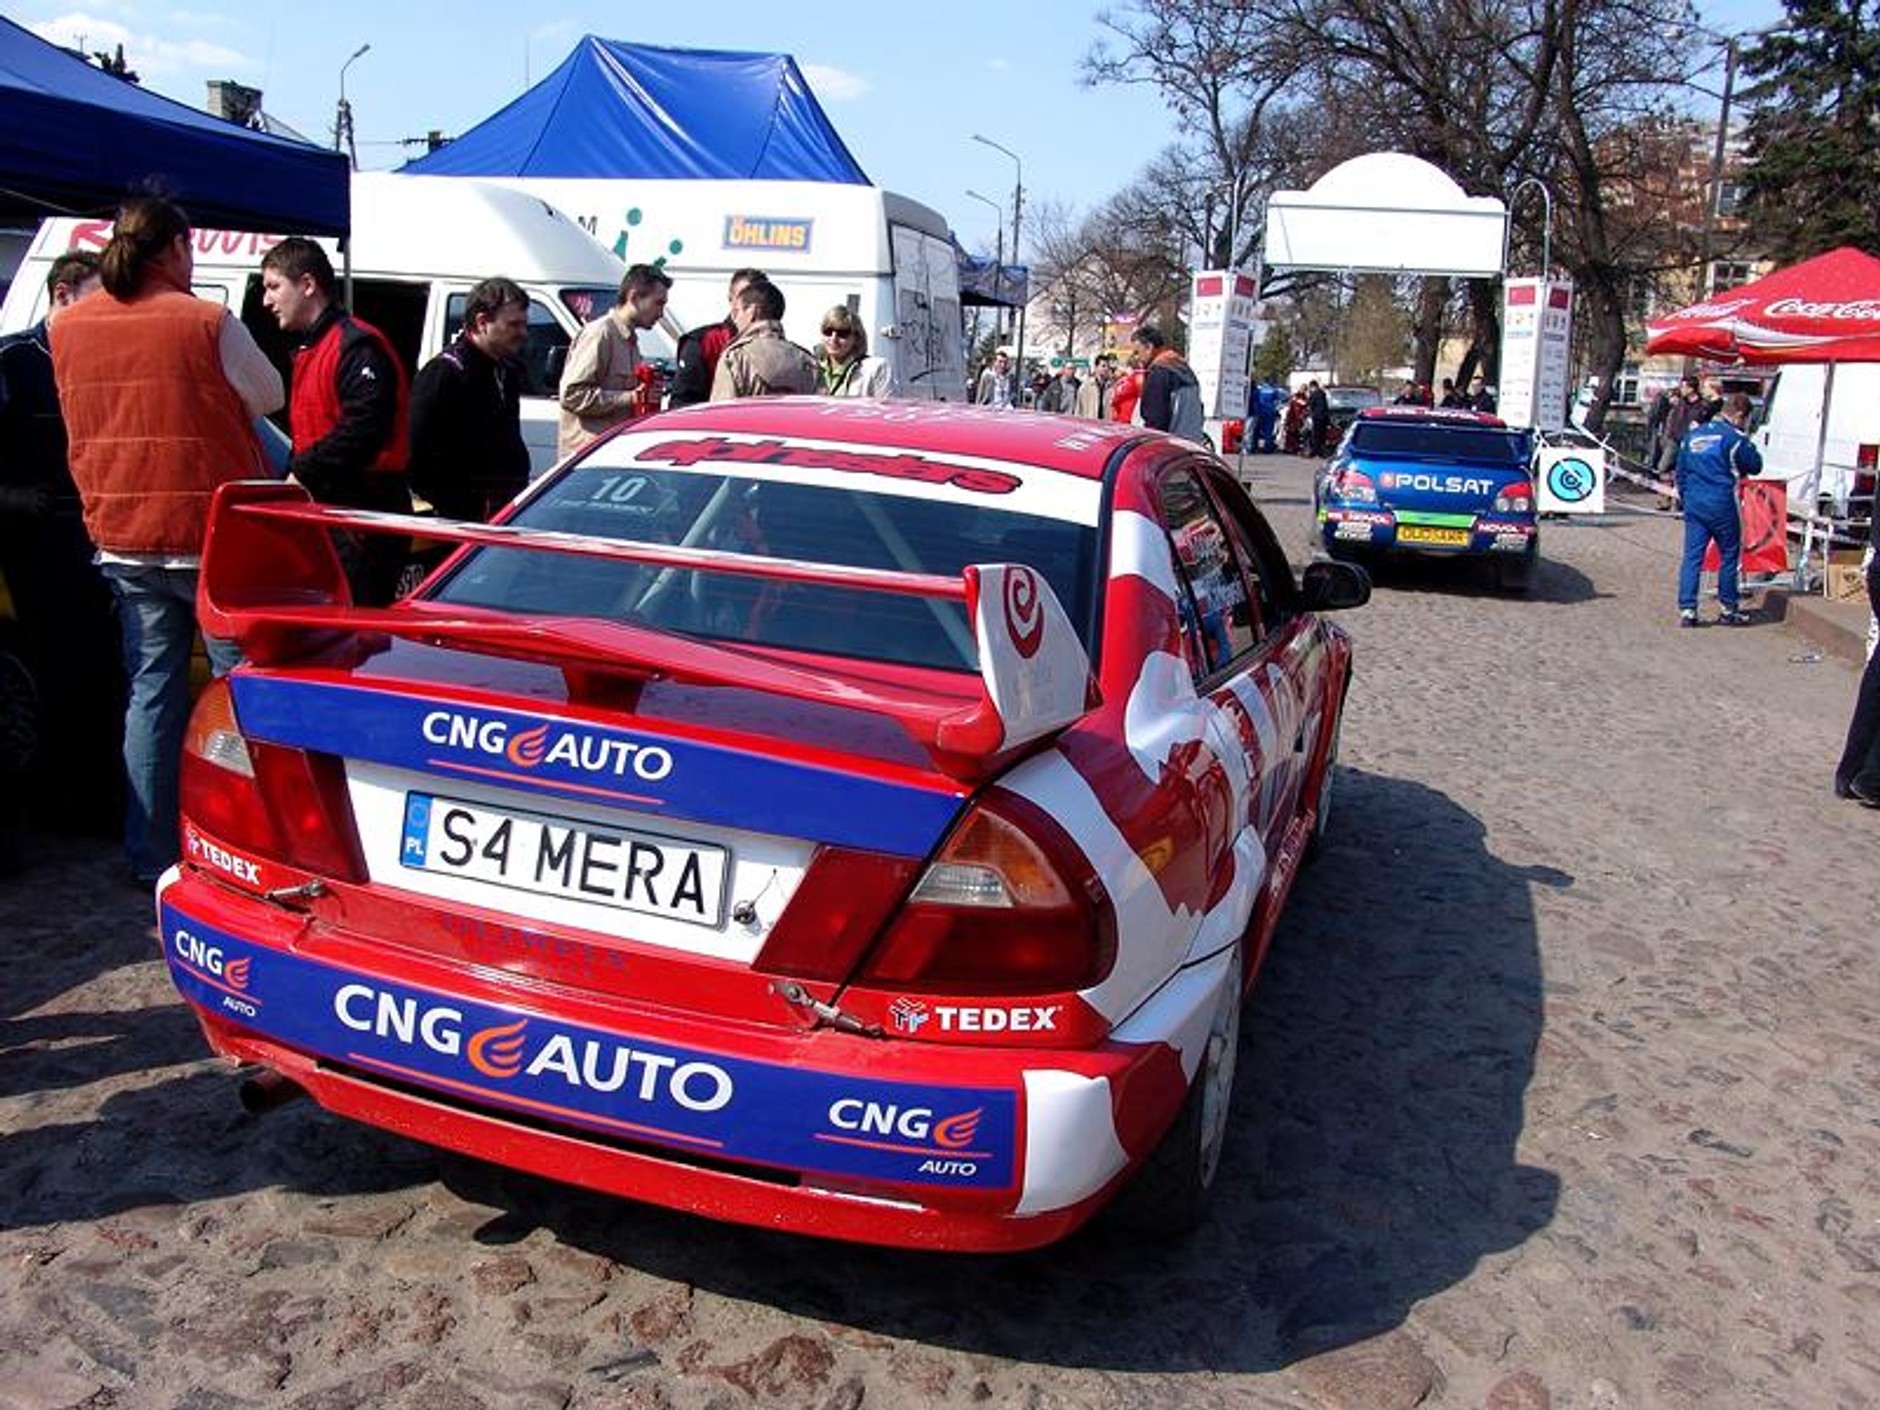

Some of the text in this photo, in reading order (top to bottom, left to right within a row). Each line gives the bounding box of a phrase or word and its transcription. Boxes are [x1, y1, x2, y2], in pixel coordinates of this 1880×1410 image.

[729, 214, 805, 248] ÖHLINS
[592, 476, 647, 502] 10
[1395, 474, 1493, 495] POLSAT
[422, 711, 673, 780] CNG AUTO
[199, 838, 261, 884] TEDEX
[406, 836, 424, 855] PL
[440, 808, 706, 914] S4 MERA
[175, 930, 223, 975] CNG
[223, 996, 256, 1017] AUTO
[935, 1006, 1058, 1031] TEDEX
[334, 984, 733, 1111] CNG AUTO
[829, 1099, 932, 1139] CNG
[918, 1160, 977, 1176] AUTO
